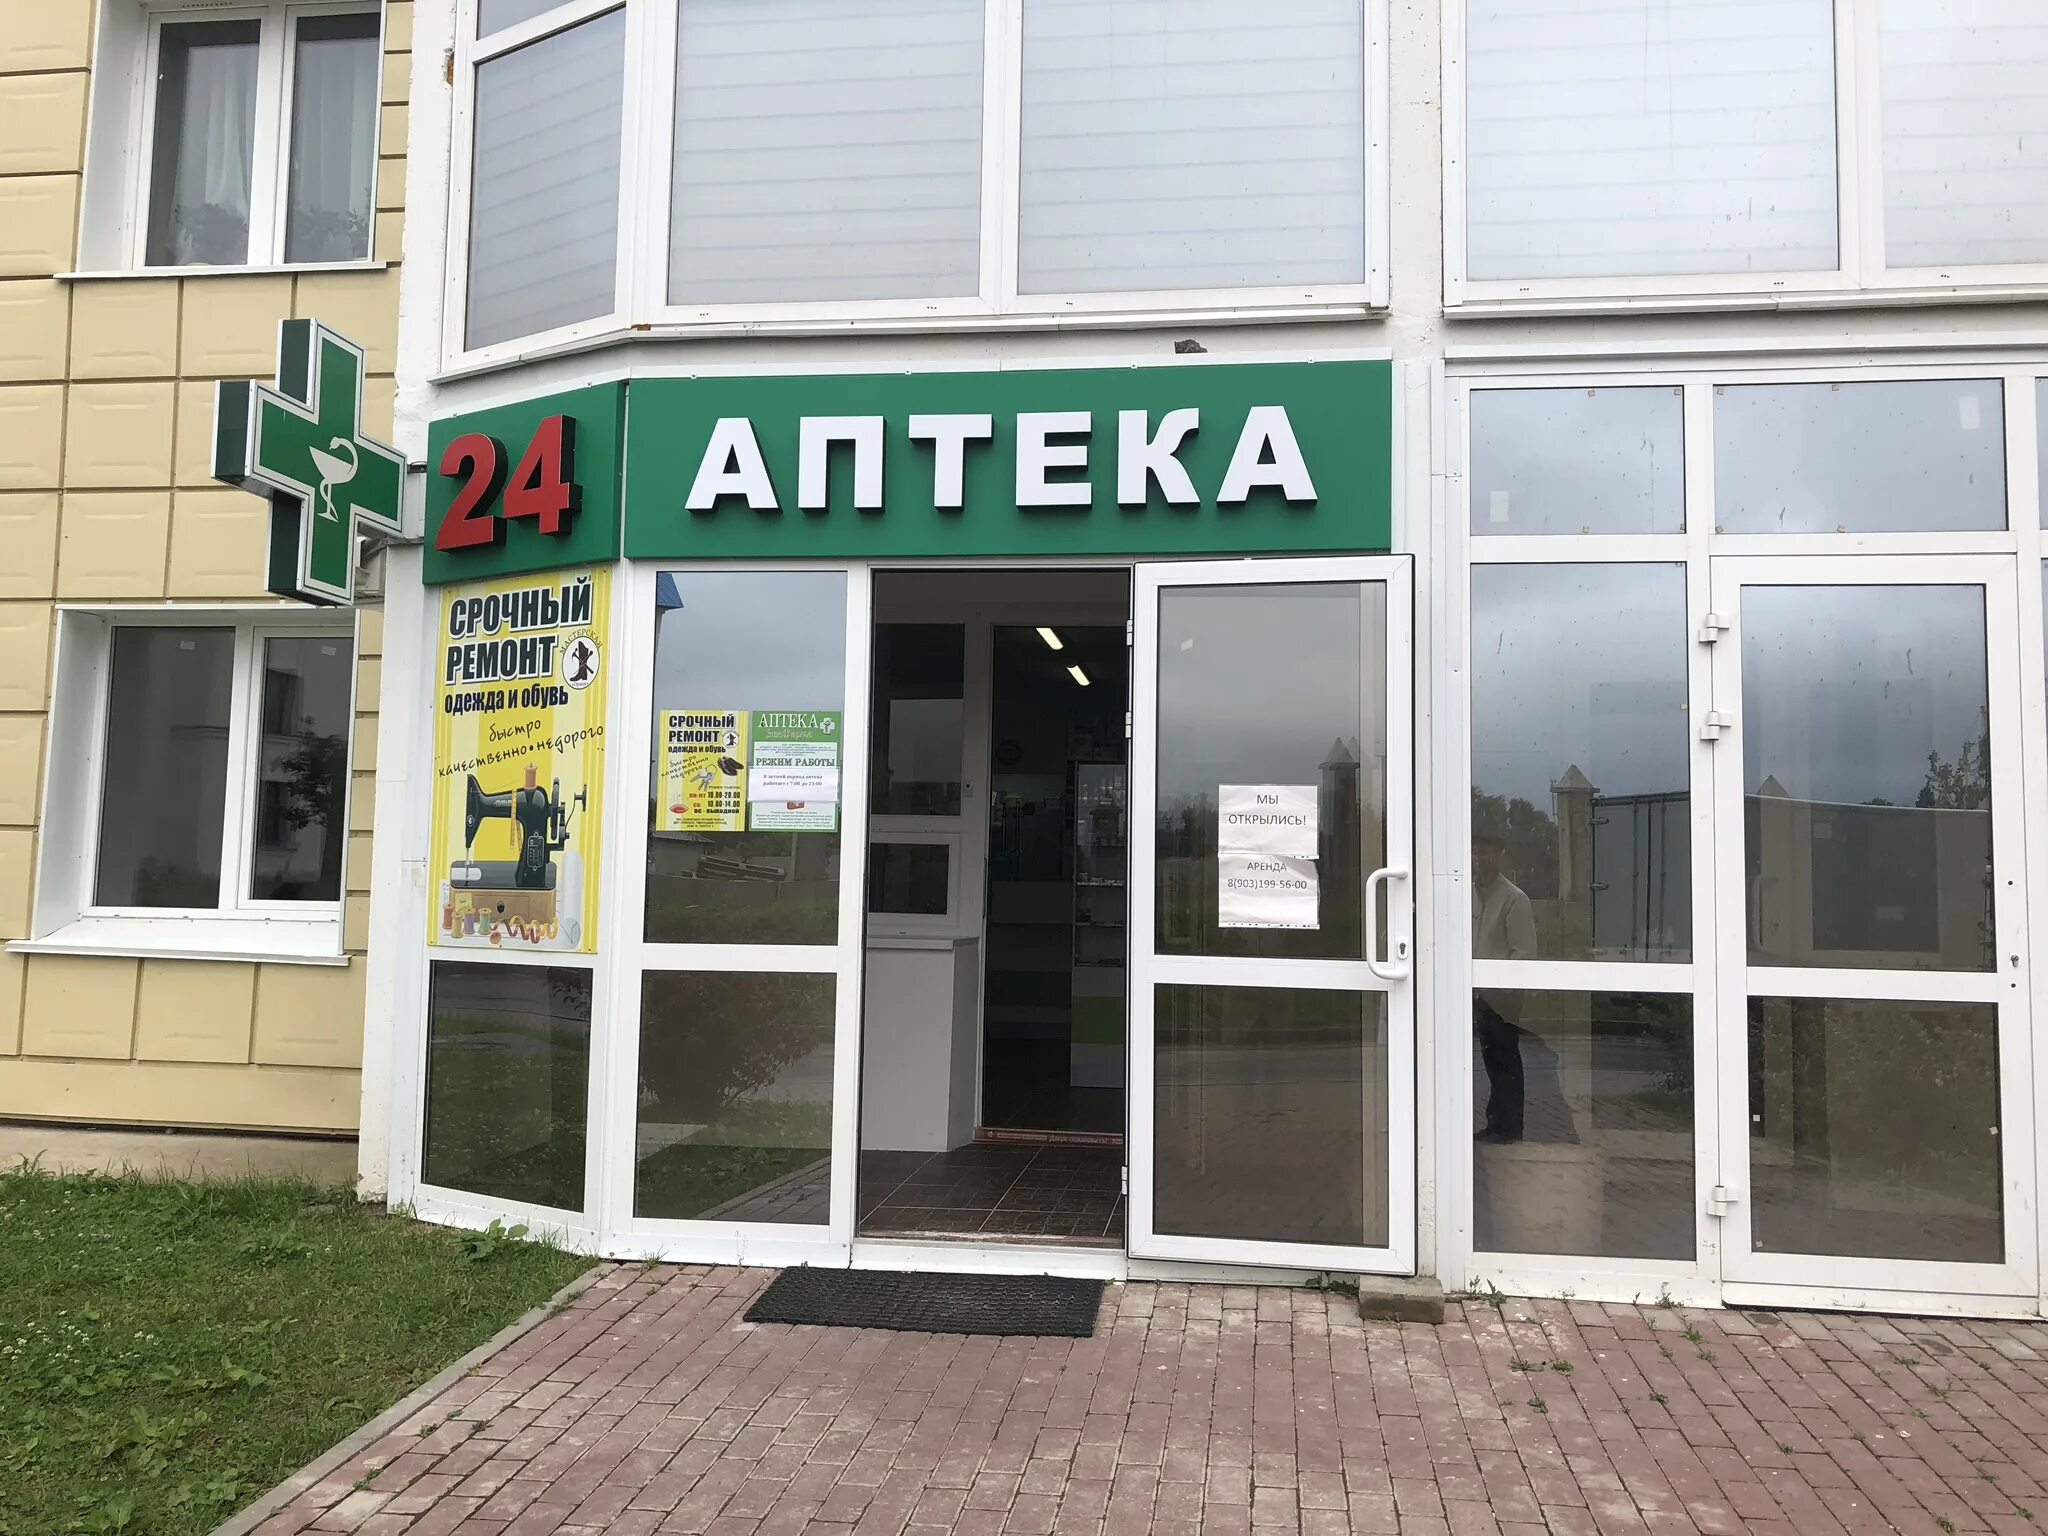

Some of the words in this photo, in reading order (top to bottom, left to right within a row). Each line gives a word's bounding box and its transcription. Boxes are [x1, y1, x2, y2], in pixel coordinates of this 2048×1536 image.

[684, 405, 1317, 512] АПТЕКА
[434, 413, 582, 552] 24
[449, 575, 594, 637] СРОЧНЫЙ
[560, 628, 603, 654] МАСТЕРСКАЯ
[446, 634, 558, 684] РЕМОНТ
[445, 690, 504, 715] одежда
[508, 691, 518, 709] и
[521, 684, 569, 709] обувь
[669, 713, 735, 728] СРОЧНЫЙ
[758, 713, 818, 728] АПТЕКА
[489, 719, 541, 742] быстро
[668, 730, 720, 742] РЕМОНТ
[438, 745, 527, 777] качественно
[537, 725, 604, 754] недорого
[668, 745, 697, 753] одежда
[698, 745, 704, 753] и
[705, 745, 726, 753] обувь
[756, 758, 793, 767] РЕЖИМ
[795, 758, 836, 767] РАБОТЫ
[1256, 794, 1279, 805] МЫ
[1228, 814, 1306, 825] ОТКРЫЛИСЬ!
[1247, 862, 1287, 873] АРЕНДА
[1227, 878, 1307, 890] 8(903)199-56-00
